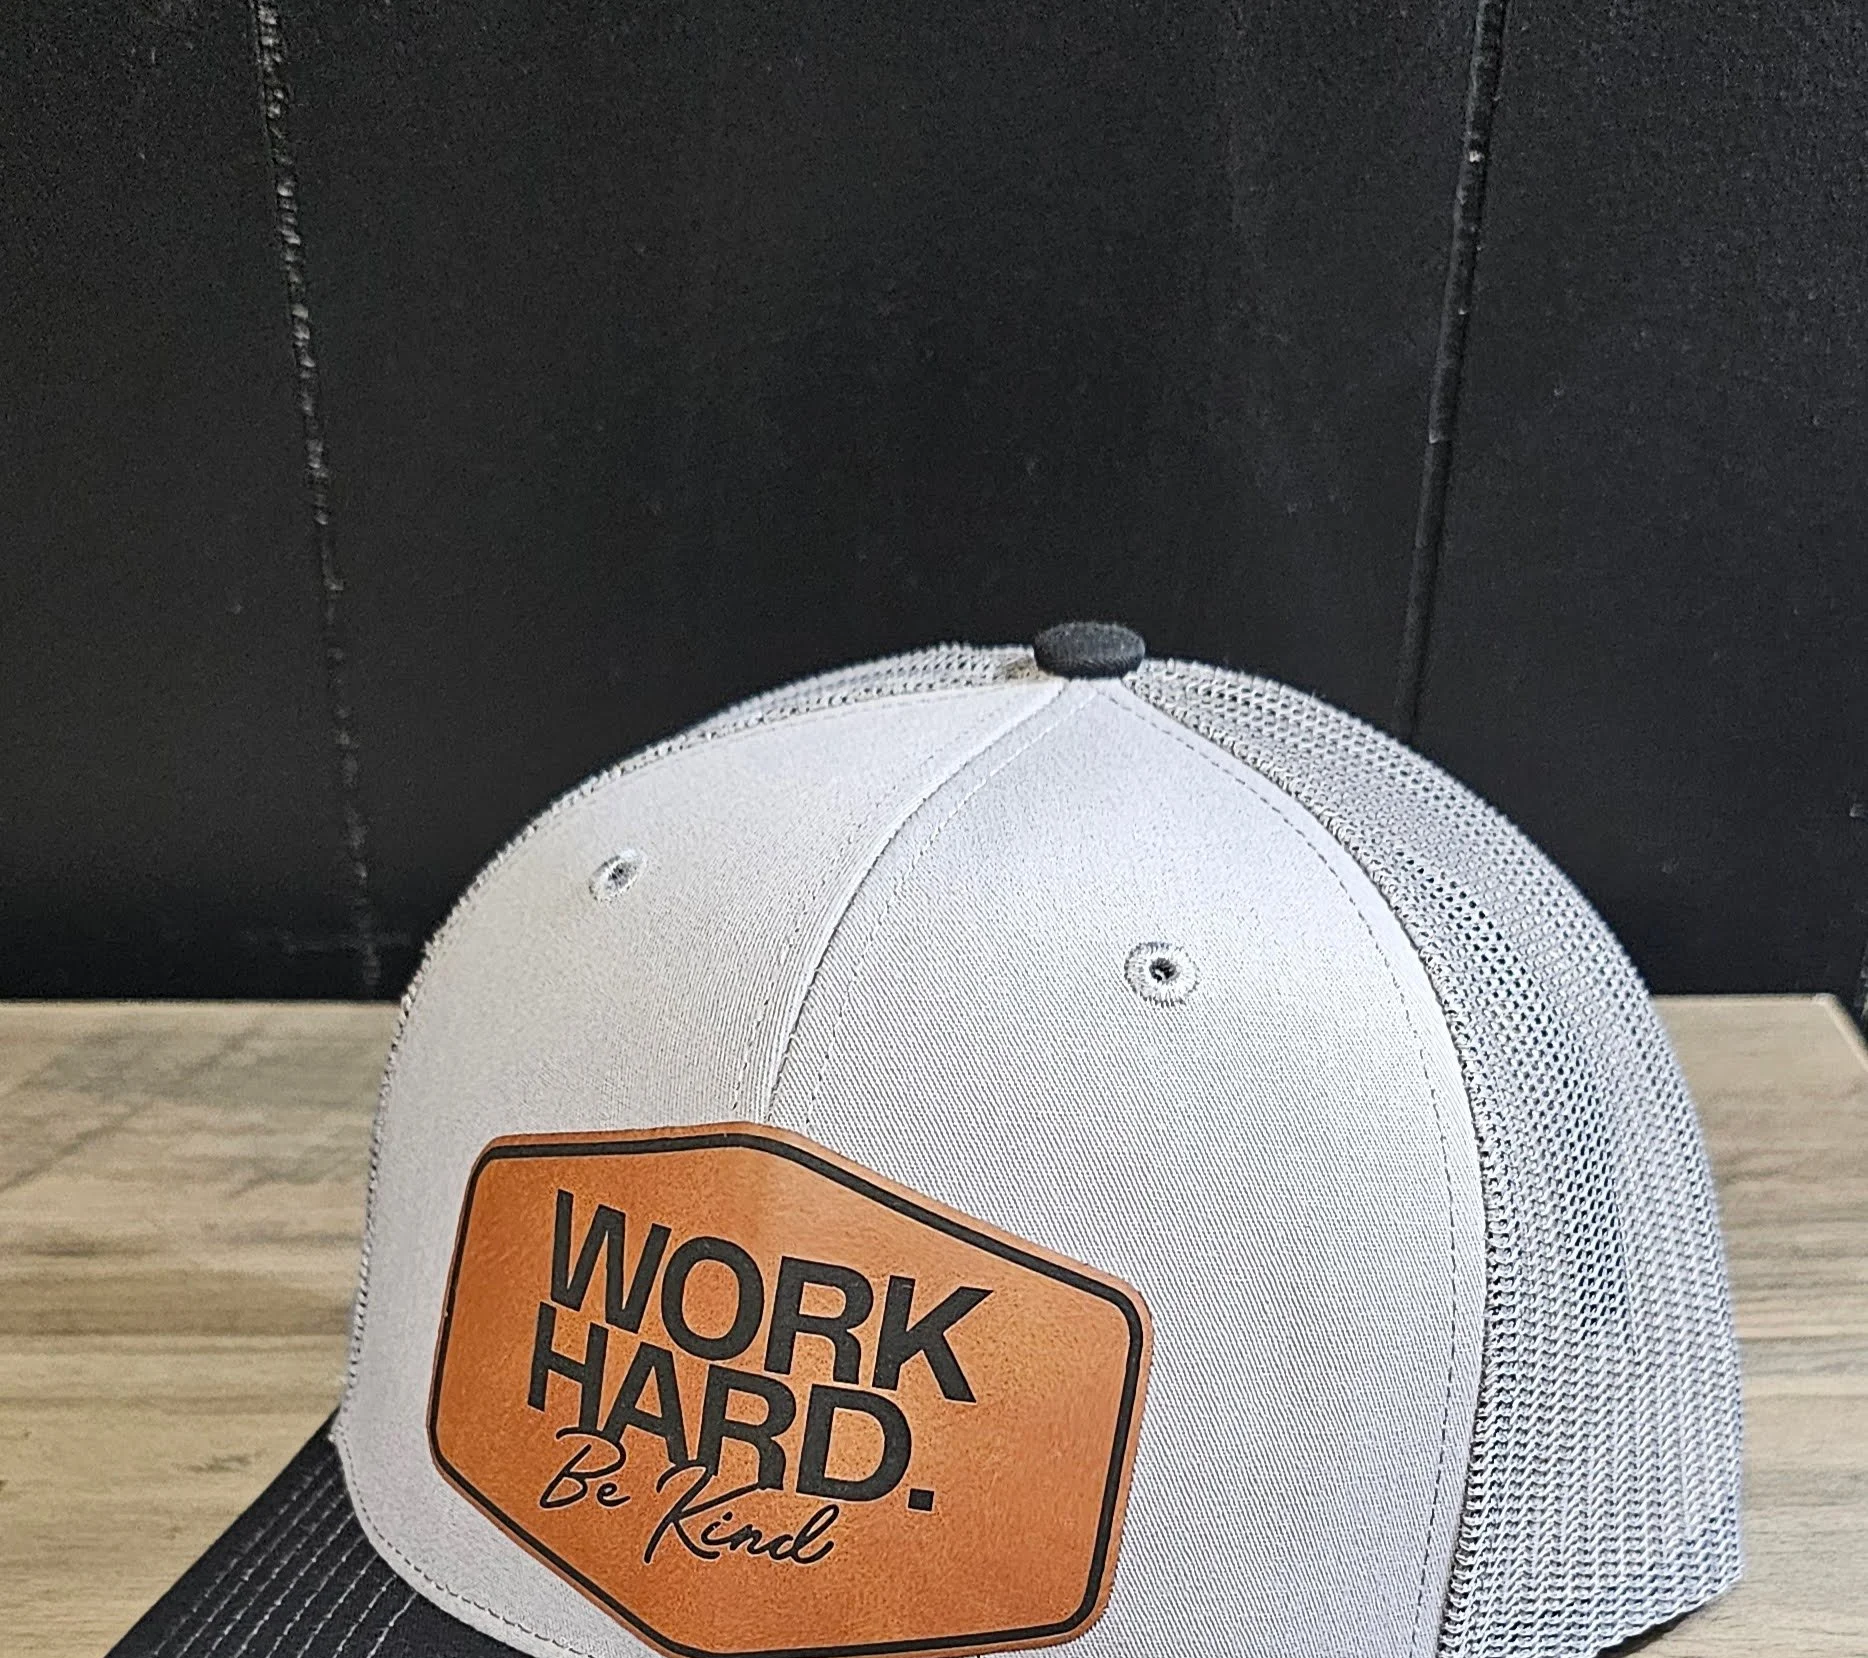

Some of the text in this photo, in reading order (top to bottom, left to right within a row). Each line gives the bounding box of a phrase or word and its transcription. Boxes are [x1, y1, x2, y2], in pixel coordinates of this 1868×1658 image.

[549, 1189, 994, 1403] WORK
[527, 1301, 935, 1512] HARD.
[539, 1427, 839, 1565] Be Kind
